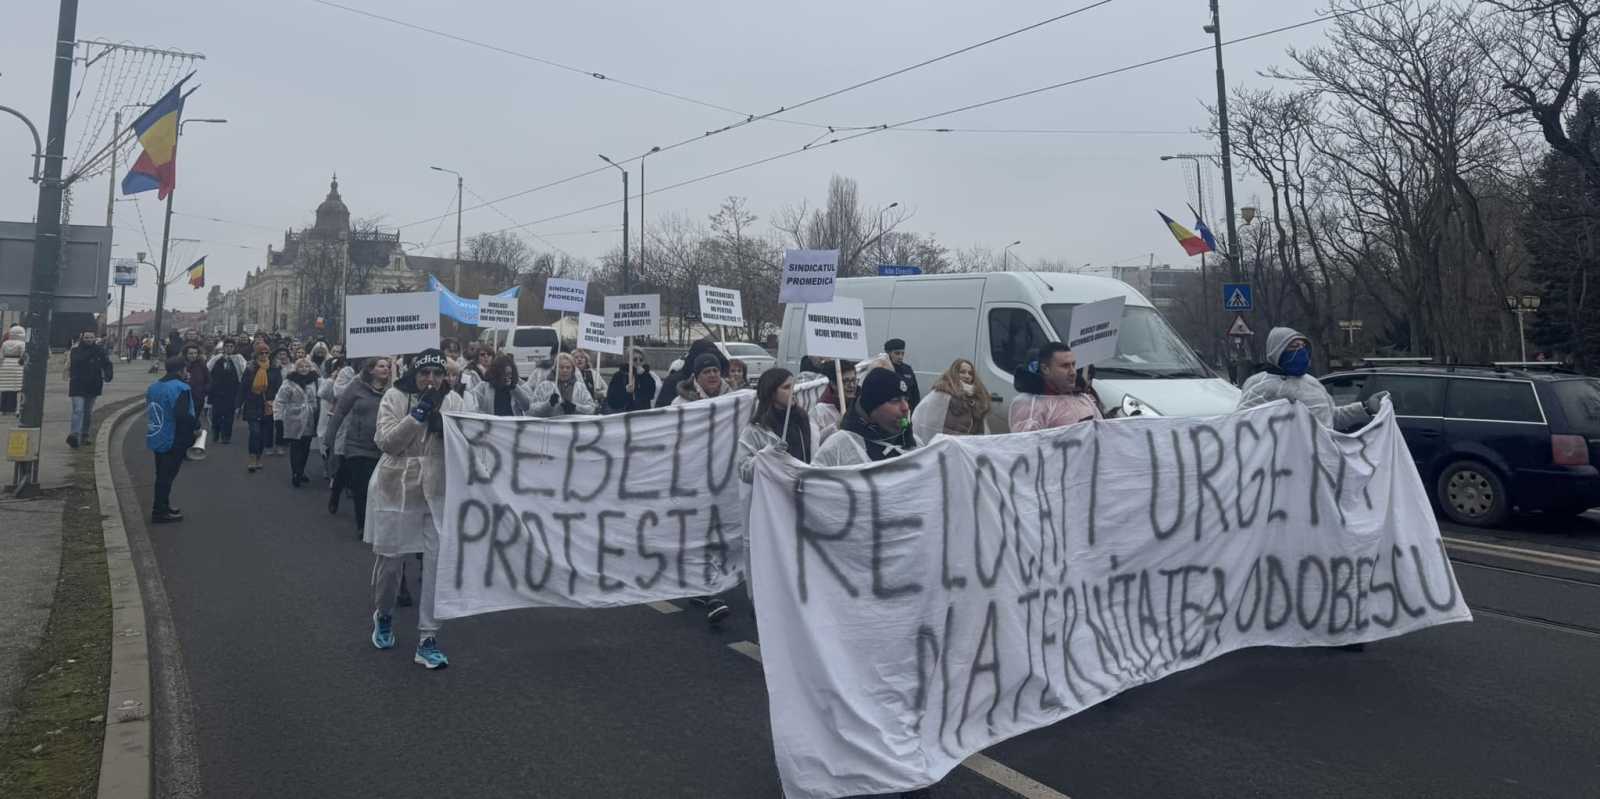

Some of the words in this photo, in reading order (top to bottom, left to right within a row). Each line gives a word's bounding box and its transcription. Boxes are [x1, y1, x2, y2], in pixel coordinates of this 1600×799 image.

[786, 277, 833, 286] PROMEDICA
[788, 263, 835, 272] SINDICATUL
[1146, 411, 1385, 542] URGENT
[1235, 537, 1457, 636] ODOBESCU
